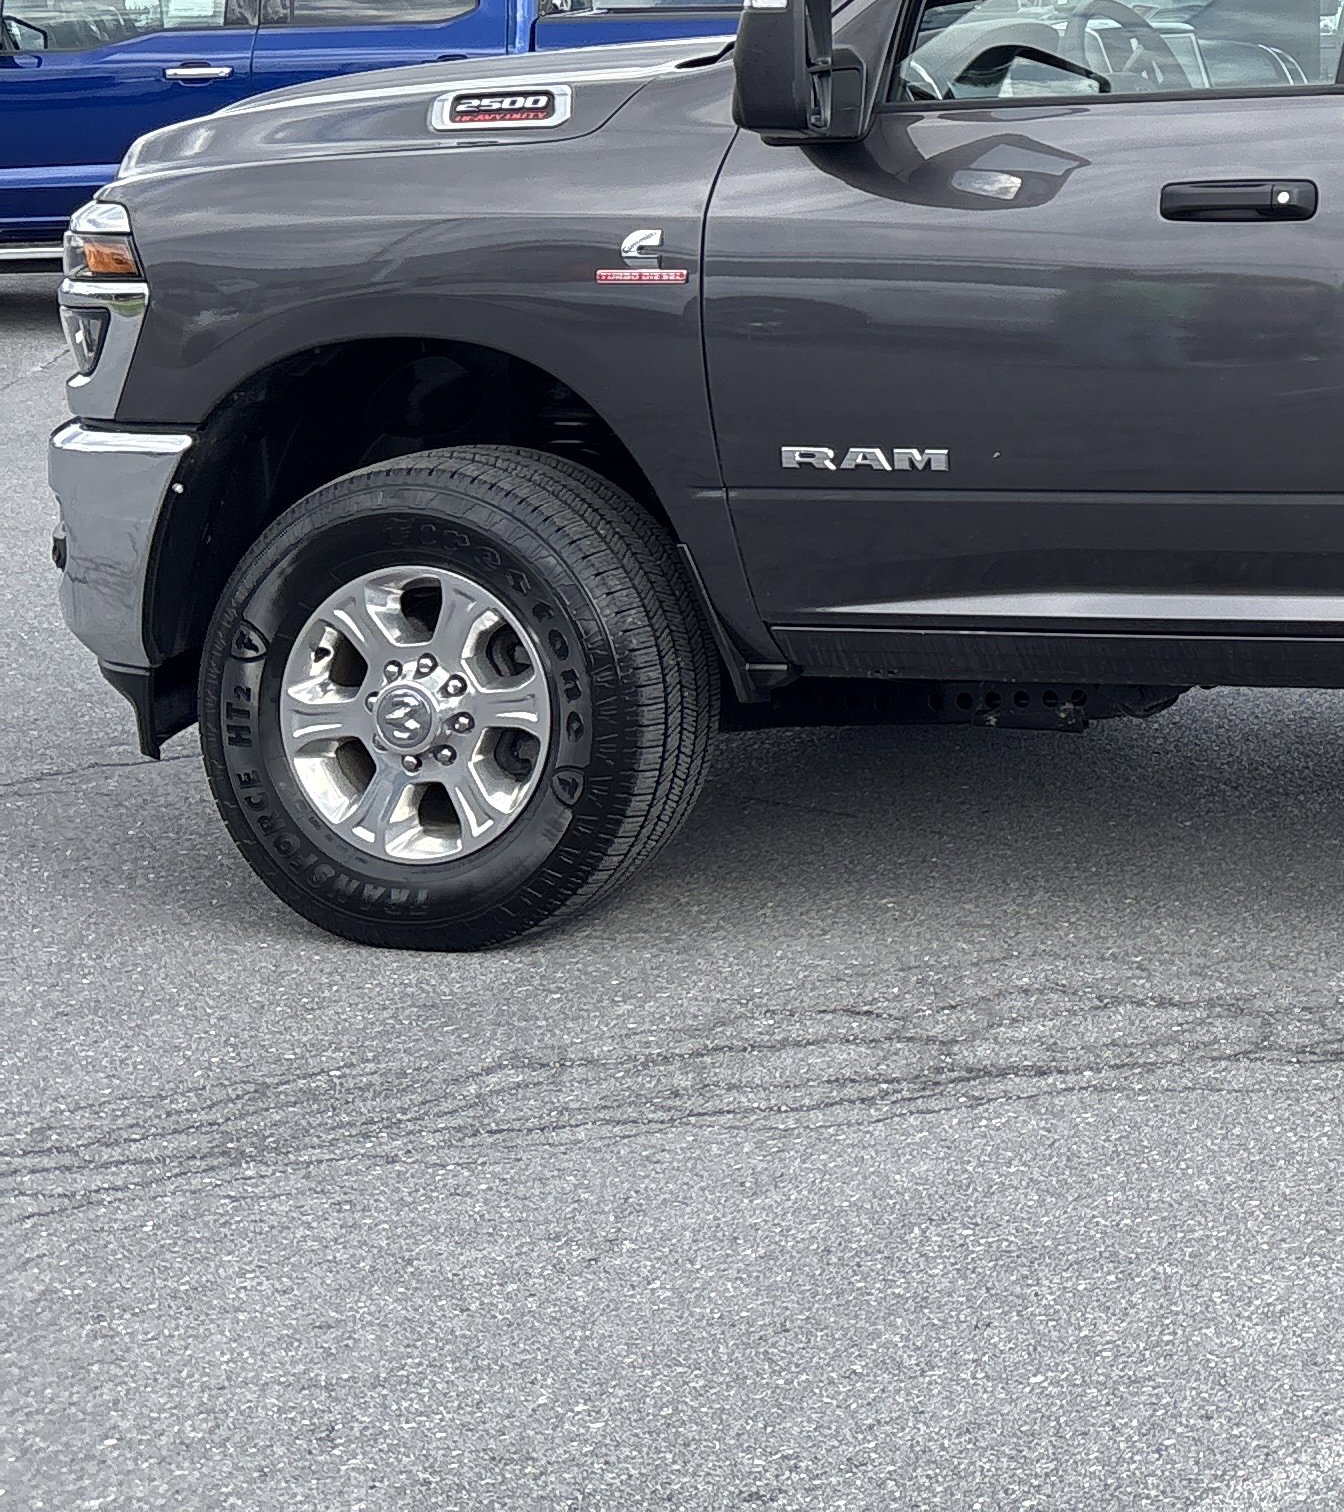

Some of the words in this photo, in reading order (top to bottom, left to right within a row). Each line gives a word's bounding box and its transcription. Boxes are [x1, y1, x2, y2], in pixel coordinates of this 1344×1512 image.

[456, 96, 549, 111] 2500
[781, 446, 949, 472] RAM
[235, 769, 430, 916] TRANSFORCE
